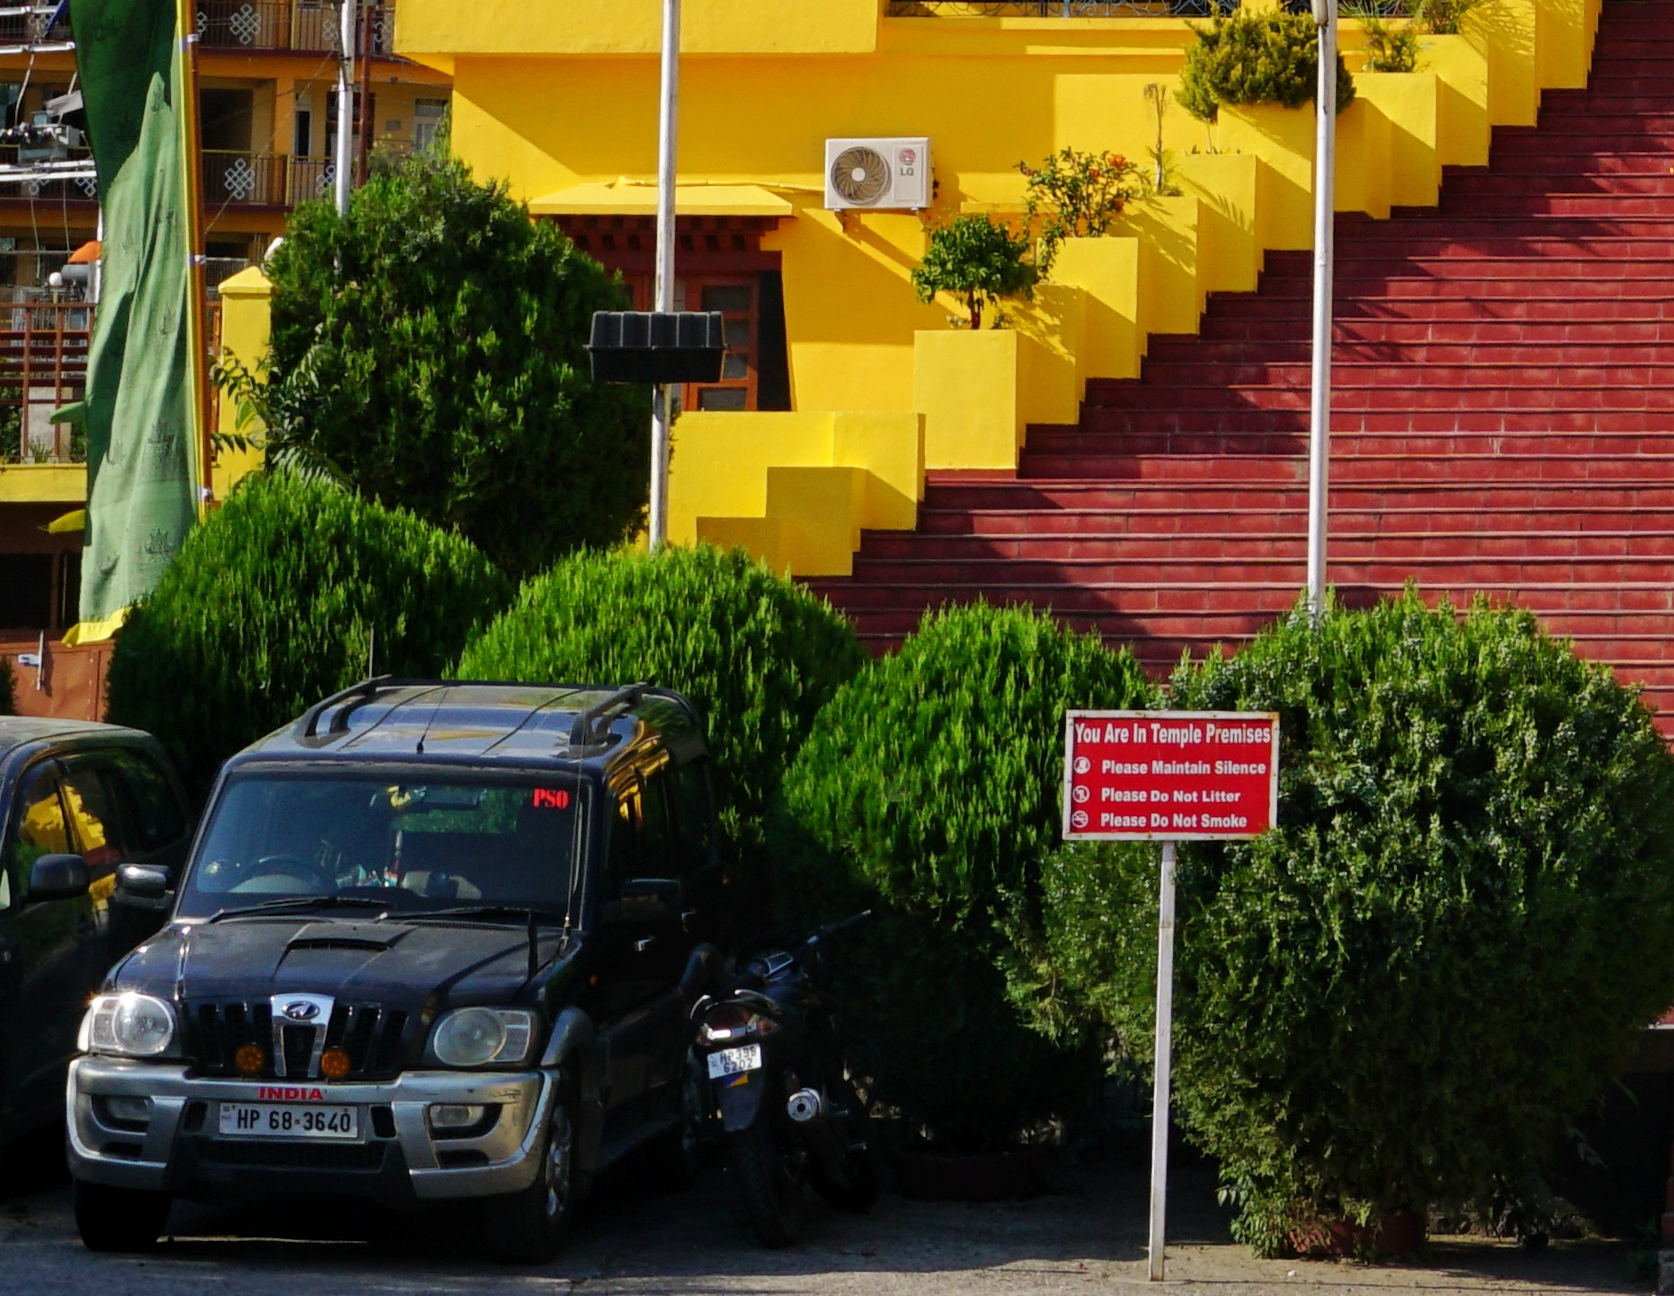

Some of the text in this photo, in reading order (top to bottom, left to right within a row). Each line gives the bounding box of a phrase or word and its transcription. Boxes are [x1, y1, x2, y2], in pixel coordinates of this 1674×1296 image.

[900, 167, 914, 176] LG
[1075, 723, 1271, 748] You Are In Temple Premises
[1101, 760, 1266, 775] Please Maintain Silence
[1101, 787, 1241, 802] Please Do Not Litter
[1100, 813, 1247, 828] Please Do Not Smoke
[723, 1057, 753, 1073] 6202
[259, 1087, 324, 1100] INDIA
[237, 1109, 260, 1129] HP
